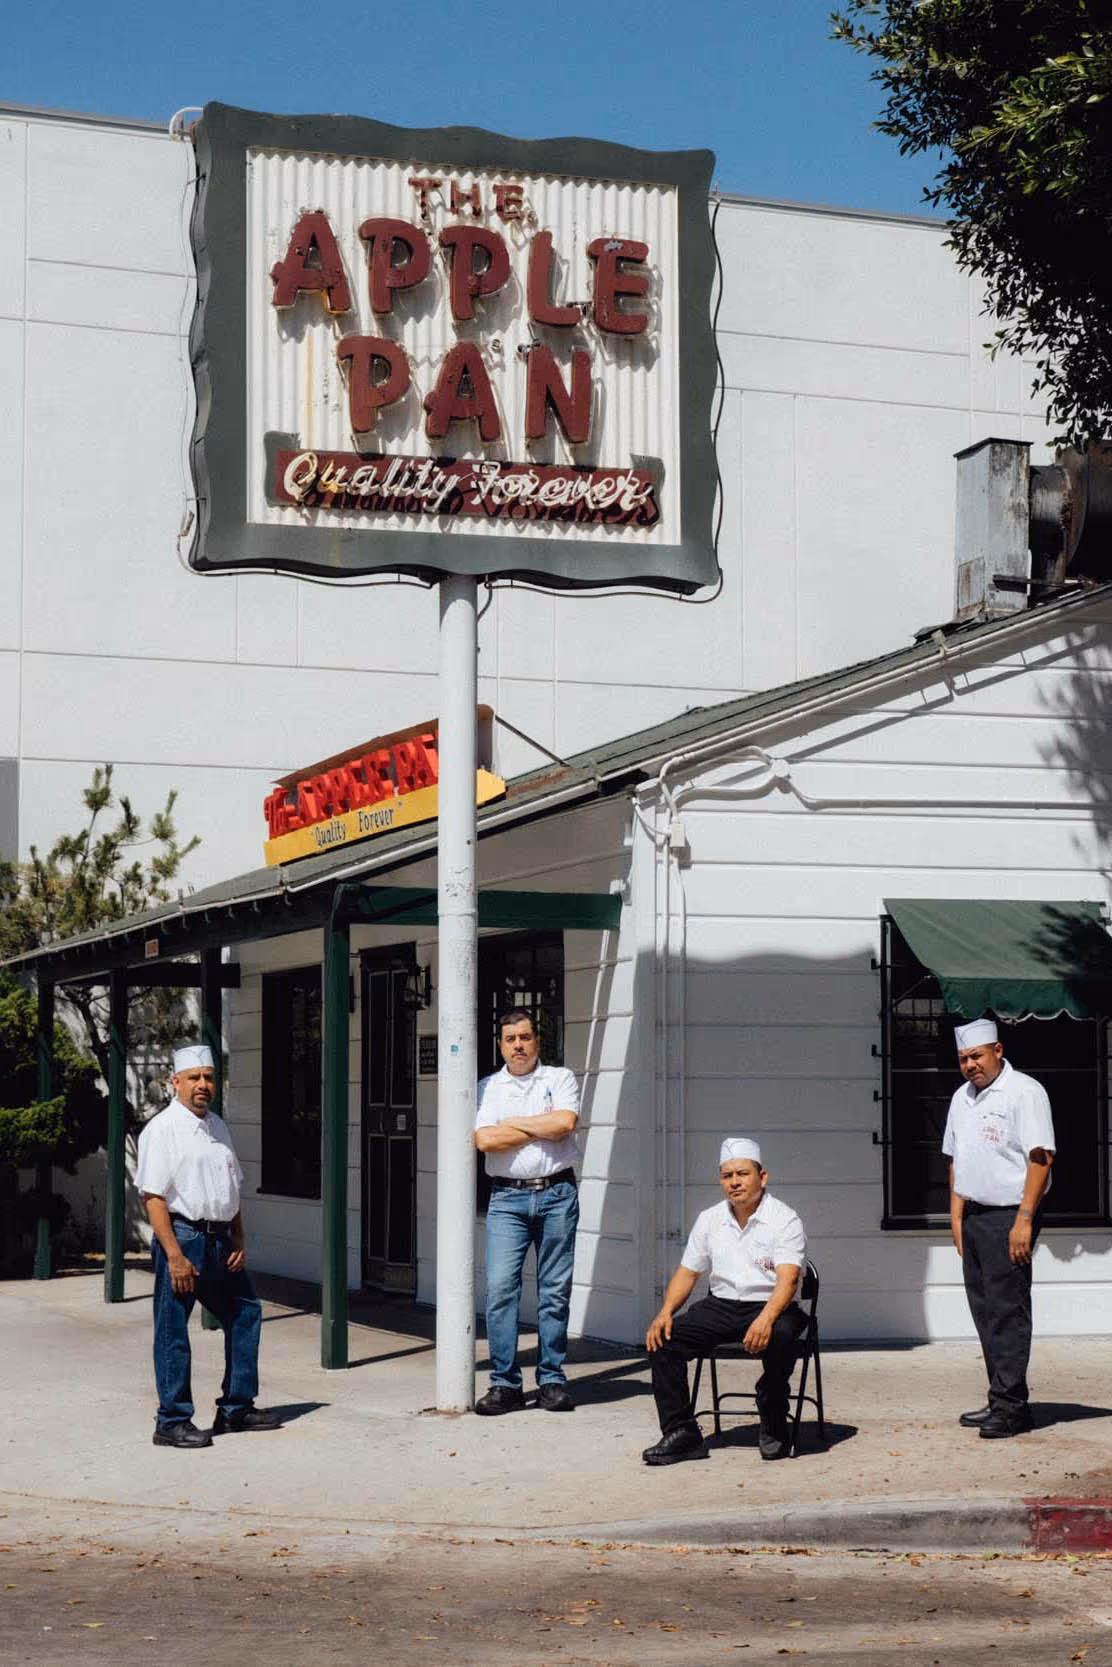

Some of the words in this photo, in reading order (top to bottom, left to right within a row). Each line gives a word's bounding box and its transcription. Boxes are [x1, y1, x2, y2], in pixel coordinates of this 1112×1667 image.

[408, 177, 525, 220] THE
[269, 208, 650, 335] APPLE
[337, 336, 592, 443] PAN
[284, 452, 460, 512] Quality
[472, 461, 654, 510] Forever
